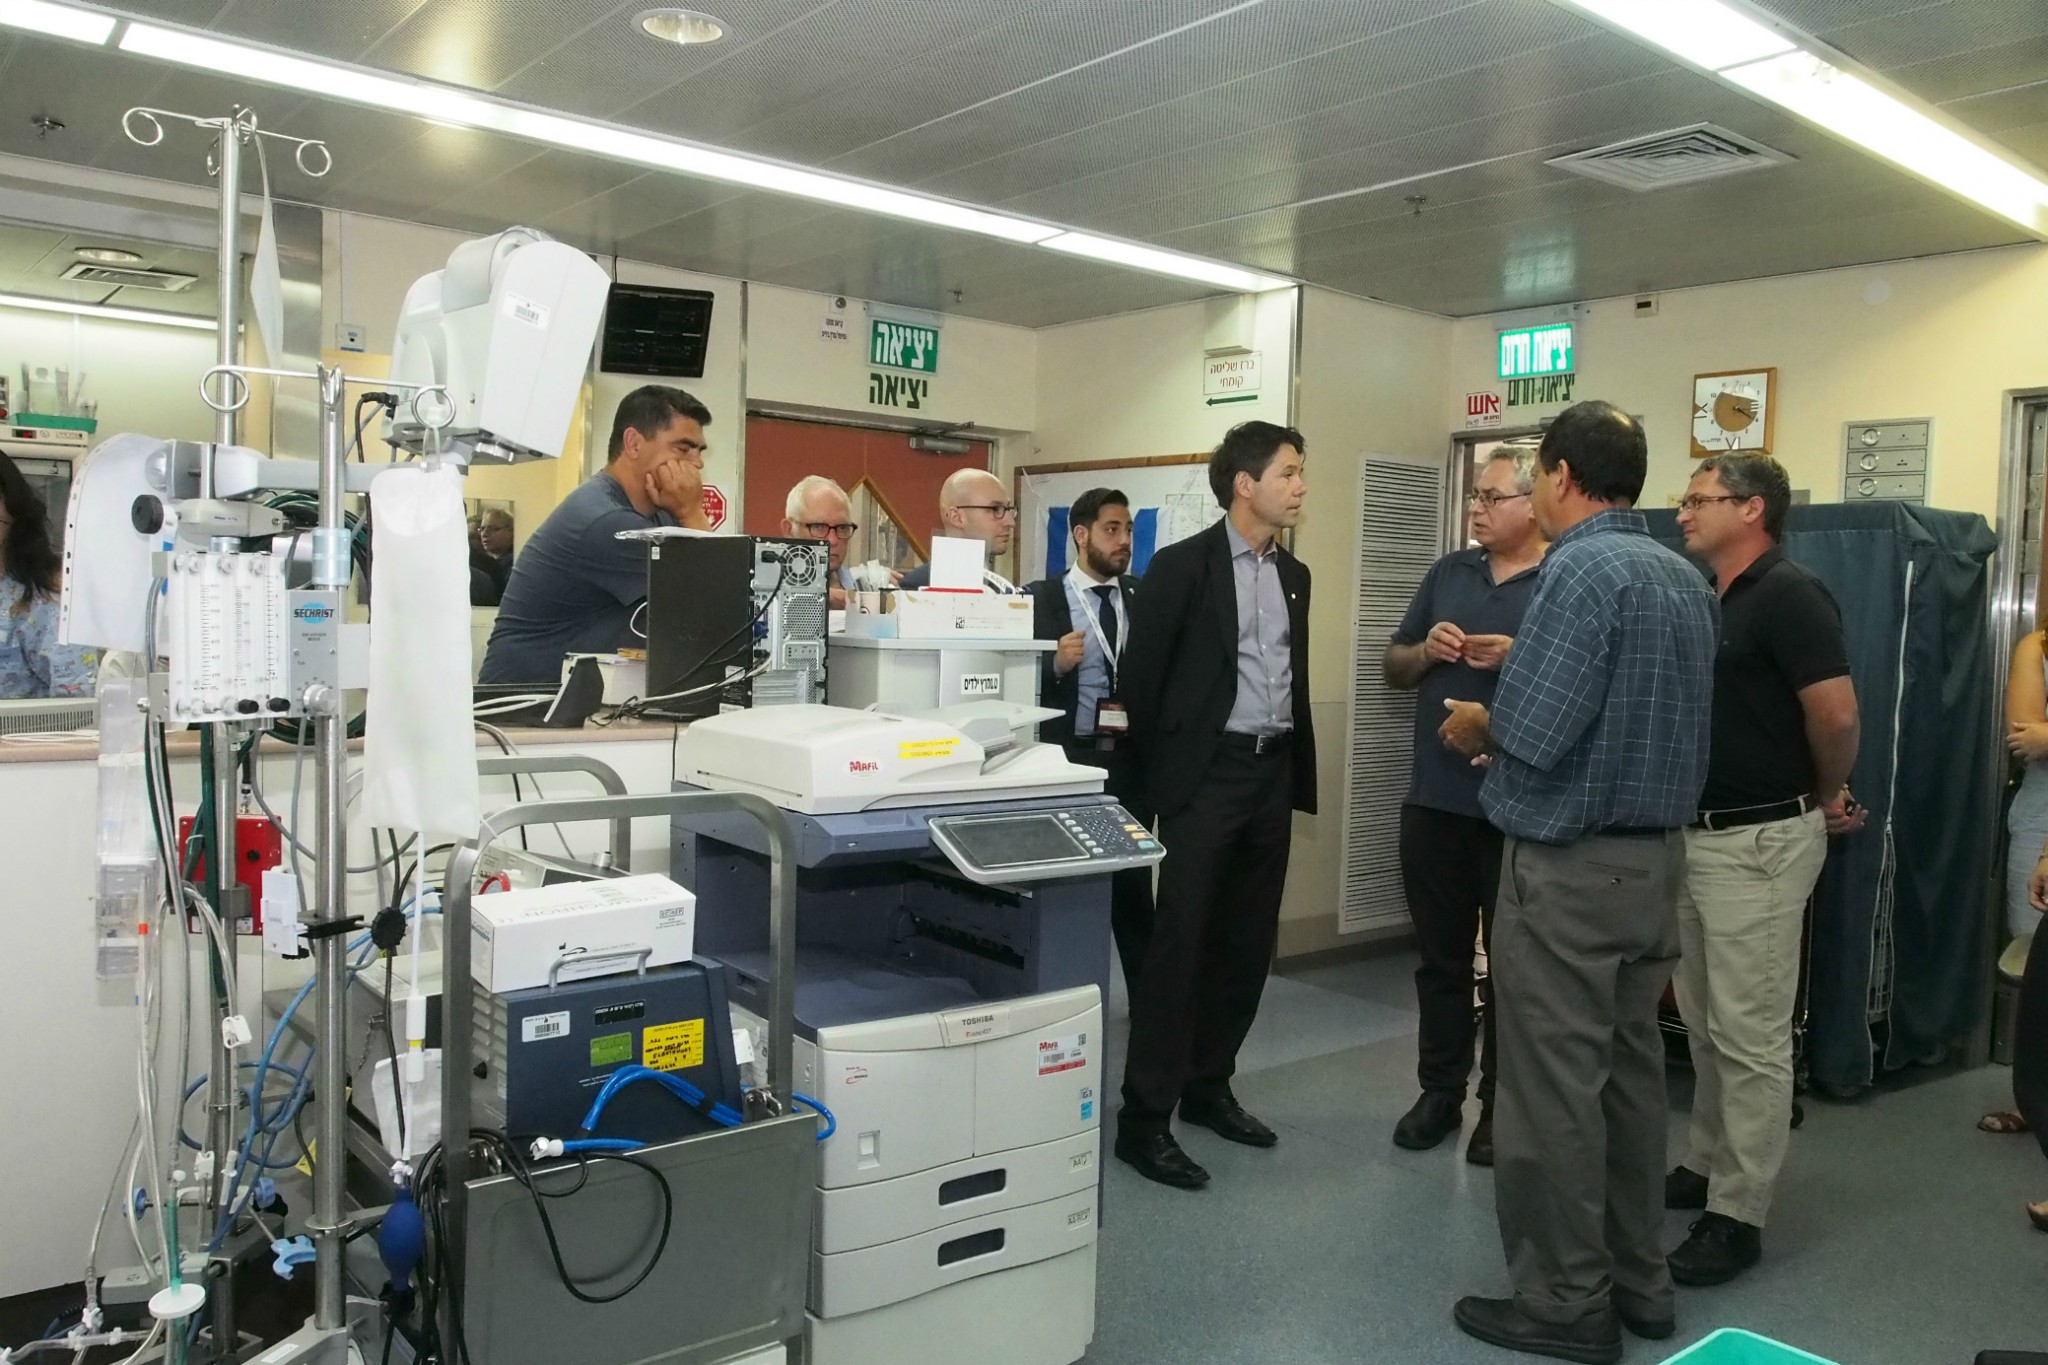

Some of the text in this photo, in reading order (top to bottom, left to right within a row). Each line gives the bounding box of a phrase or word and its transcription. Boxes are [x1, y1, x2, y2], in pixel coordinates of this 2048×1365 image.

[875, 323, 933, 369] יציאה
[1501, 327, 1572, 377] יציאת חרום
[1210, 361, 1237, 374] שליטה
[869, 372, 928, 410] יציאה
[1508, 373, 1575, 406] יציאת חרום
[1468, 394, 1500, 416] אש
[294, 608, 335, 618] SECHRIST
[964, 676, 980, 691] ילדים
[962, 1015, 994, 1026] TOSHIBA
